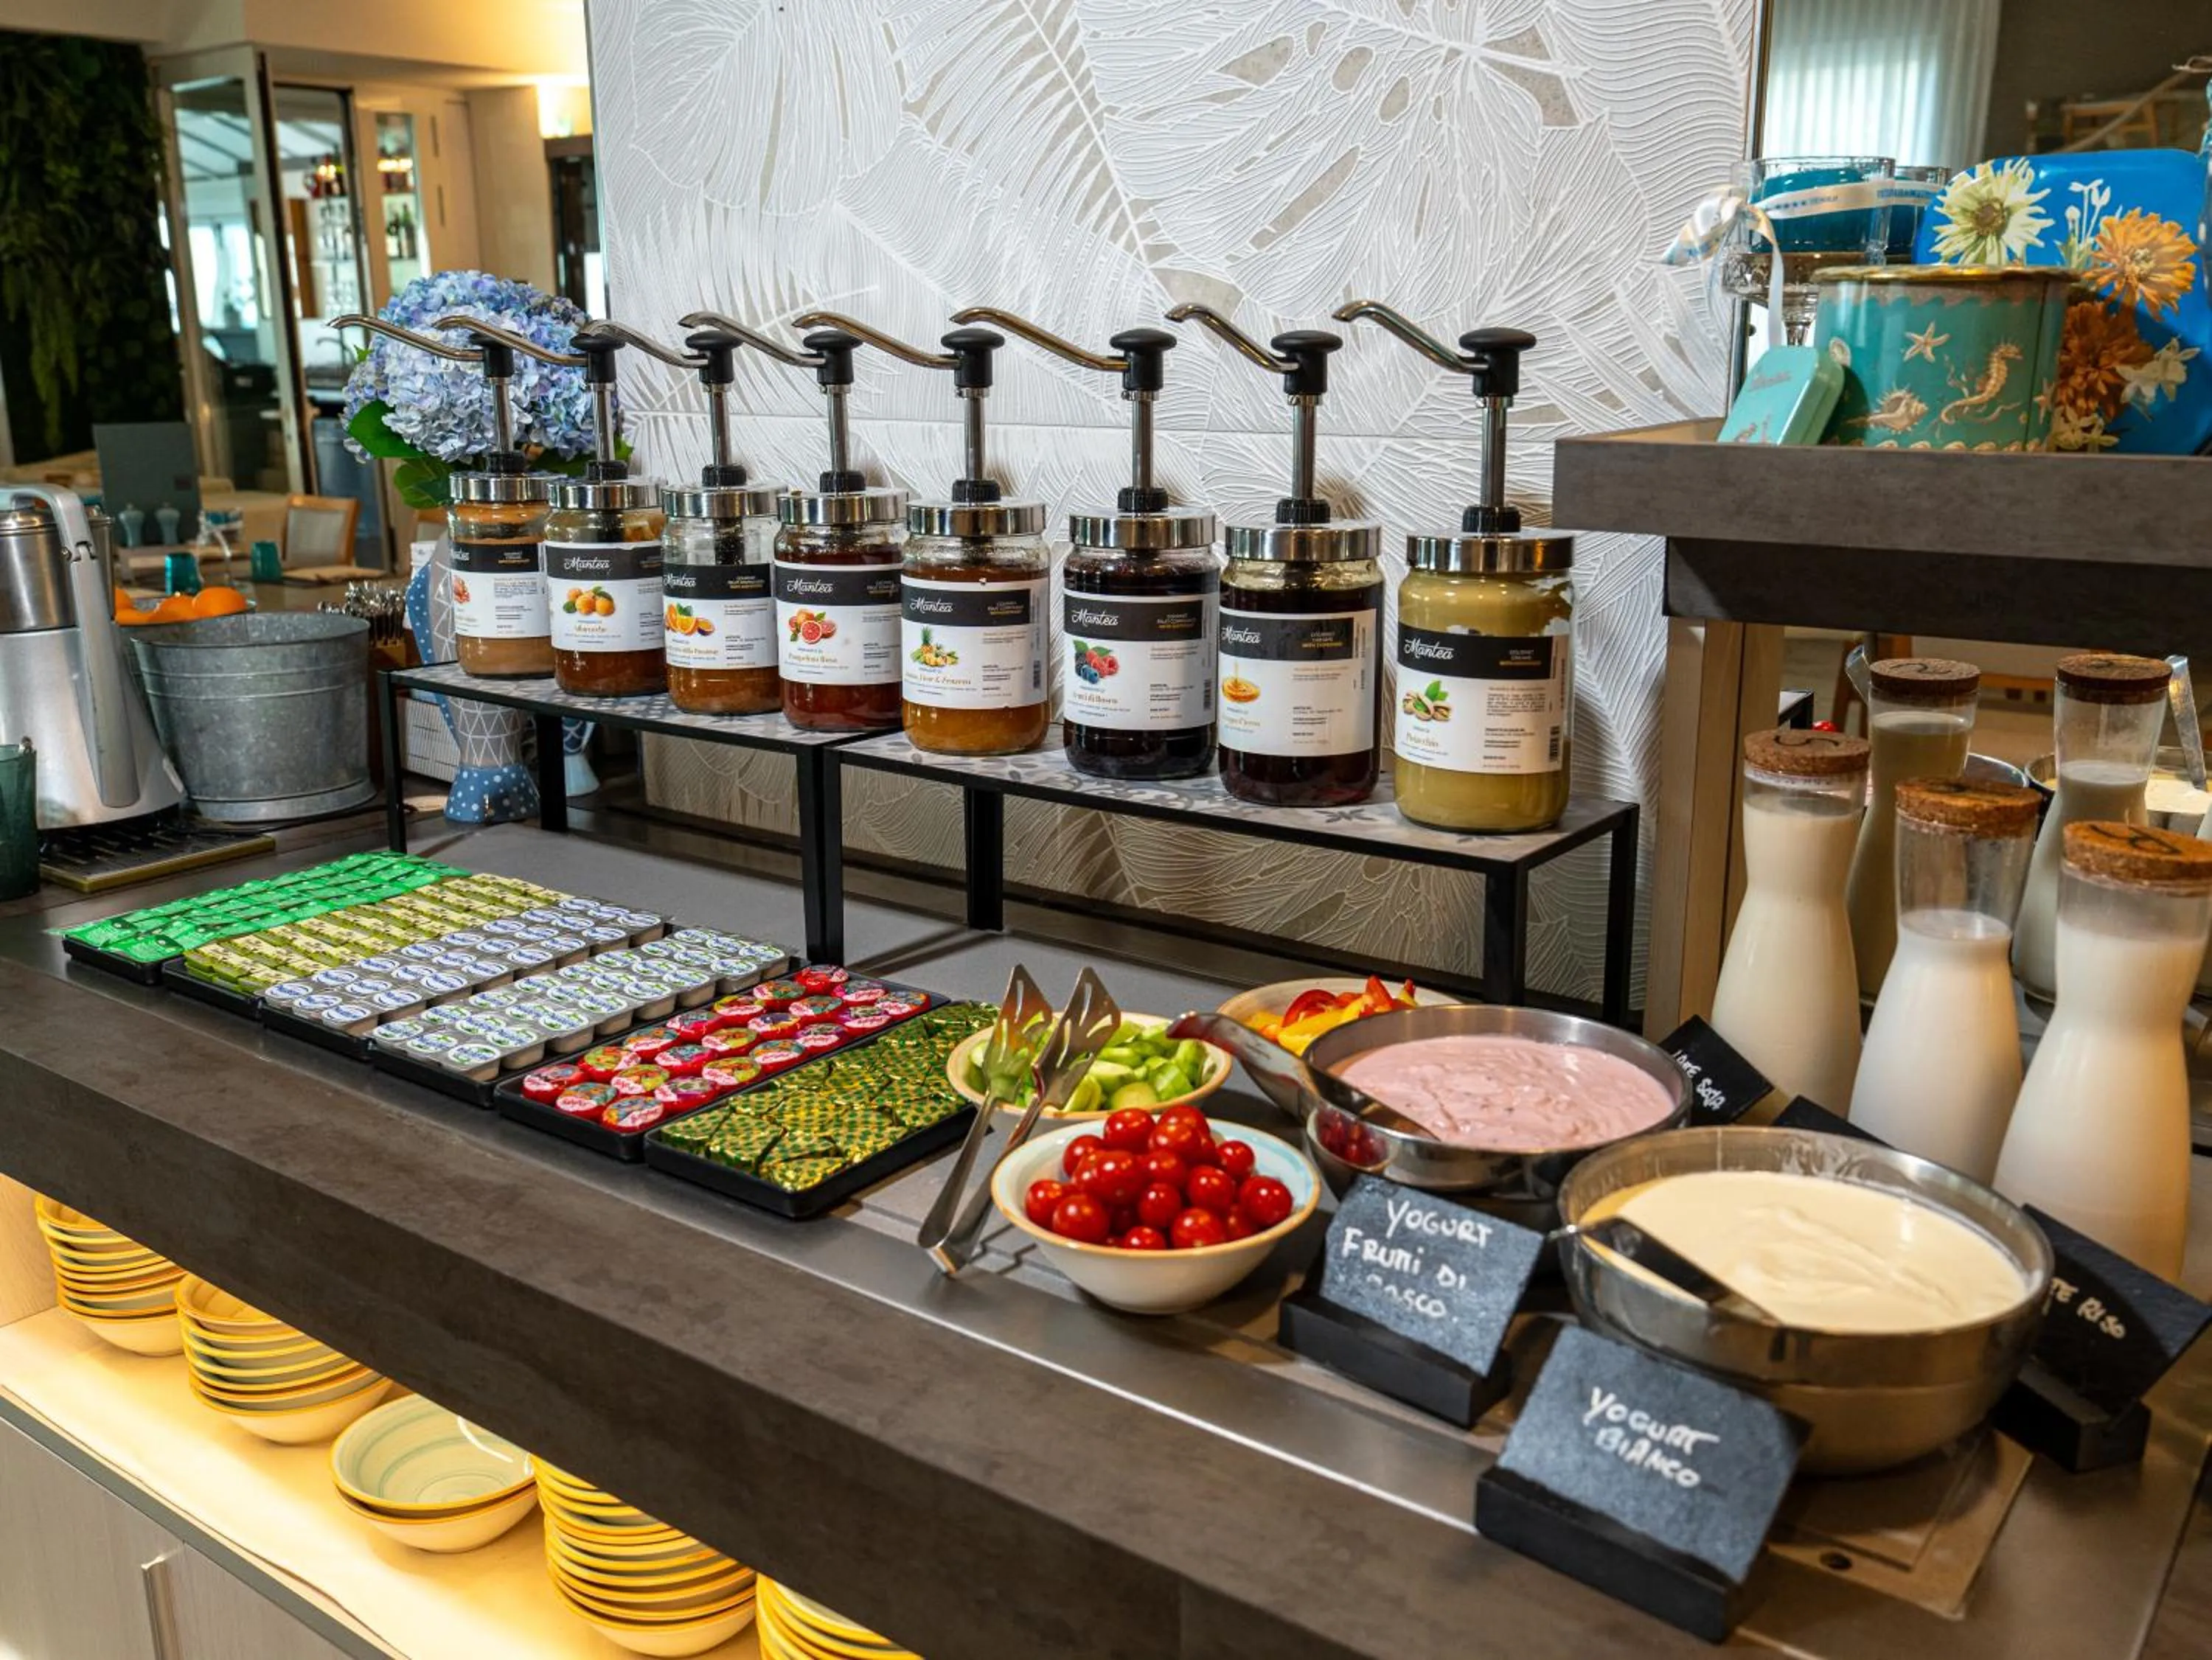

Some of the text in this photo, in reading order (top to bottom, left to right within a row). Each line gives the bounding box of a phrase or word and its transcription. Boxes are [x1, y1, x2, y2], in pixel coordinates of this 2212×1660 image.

[563, 557, 611, 571] Mantea
[787, 579, 834, 594] Mantea
[909, 596, 953, 613] Mantea
[1071, 608, 1119, 627] Mantea
[1220, 626, 1262, 644] Mantea
[1403, 637, 1455, 660] Mantea
[1386, 1199, 1493, 1249] YOGURT
[1582, 1386, 1721, 1455] YOGURT
[1595, 1426, 1701, 1488] BIANCO
